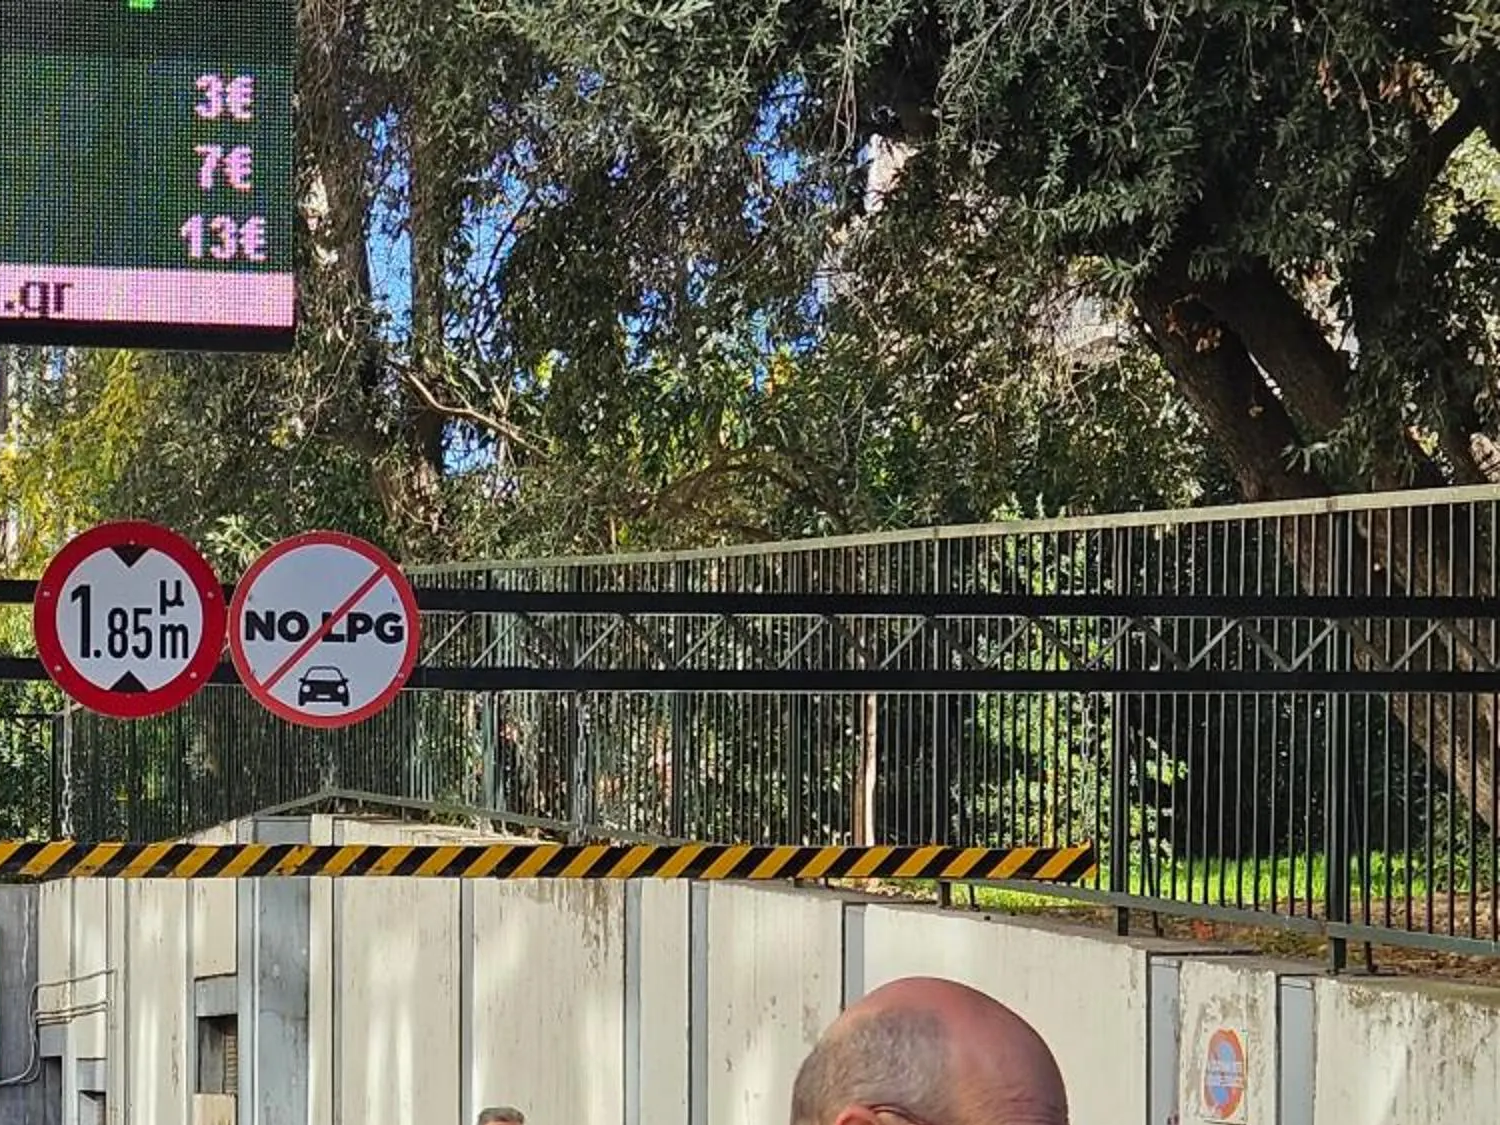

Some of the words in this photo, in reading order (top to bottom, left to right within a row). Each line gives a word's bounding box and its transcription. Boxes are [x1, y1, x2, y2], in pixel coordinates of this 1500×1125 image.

[194, 72, 256, 122] 3€
[193, 144, 254, 192] 7€
[180, 214, 268, 262] 13€
[244, 610, 310, 642] NO
[320, 611, 405, 645] LPG
